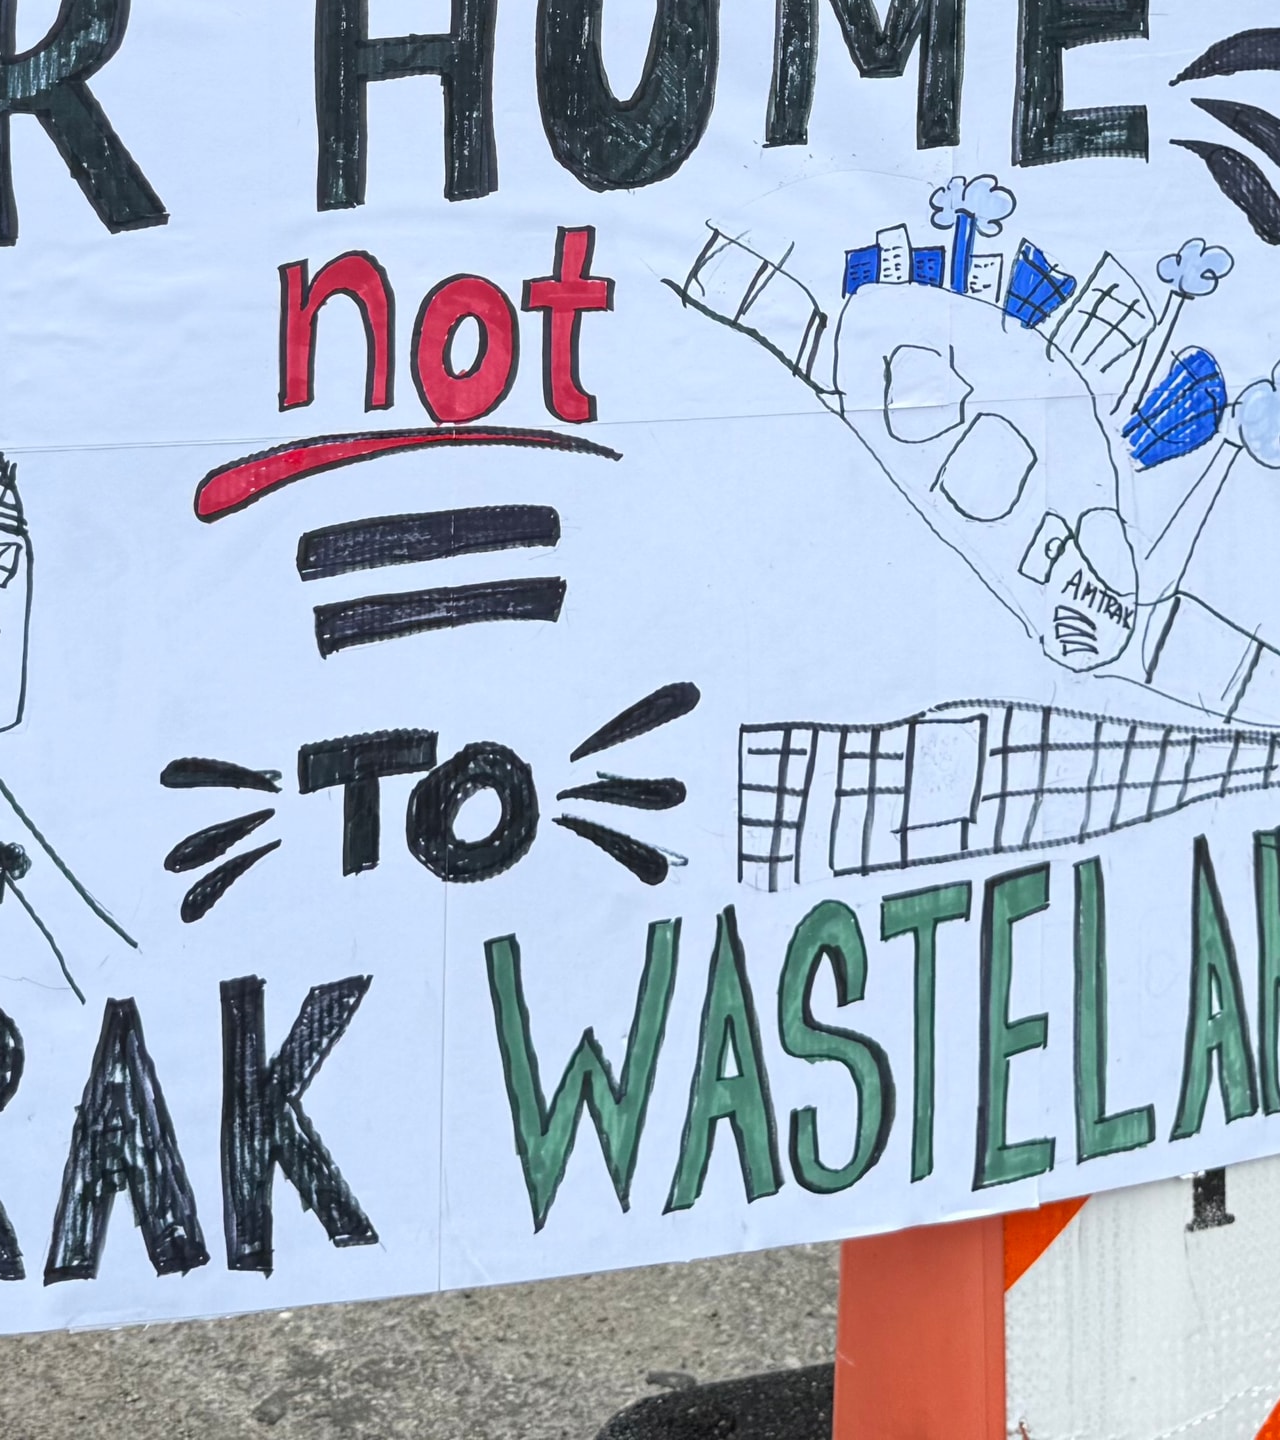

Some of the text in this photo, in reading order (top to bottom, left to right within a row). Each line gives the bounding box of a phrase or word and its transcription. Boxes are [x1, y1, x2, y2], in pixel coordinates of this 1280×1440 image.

[278, 225, 613, 424] not
[1061, 569, 1135, 630] AMTRAK
[297, 728, 540, 883] TO
